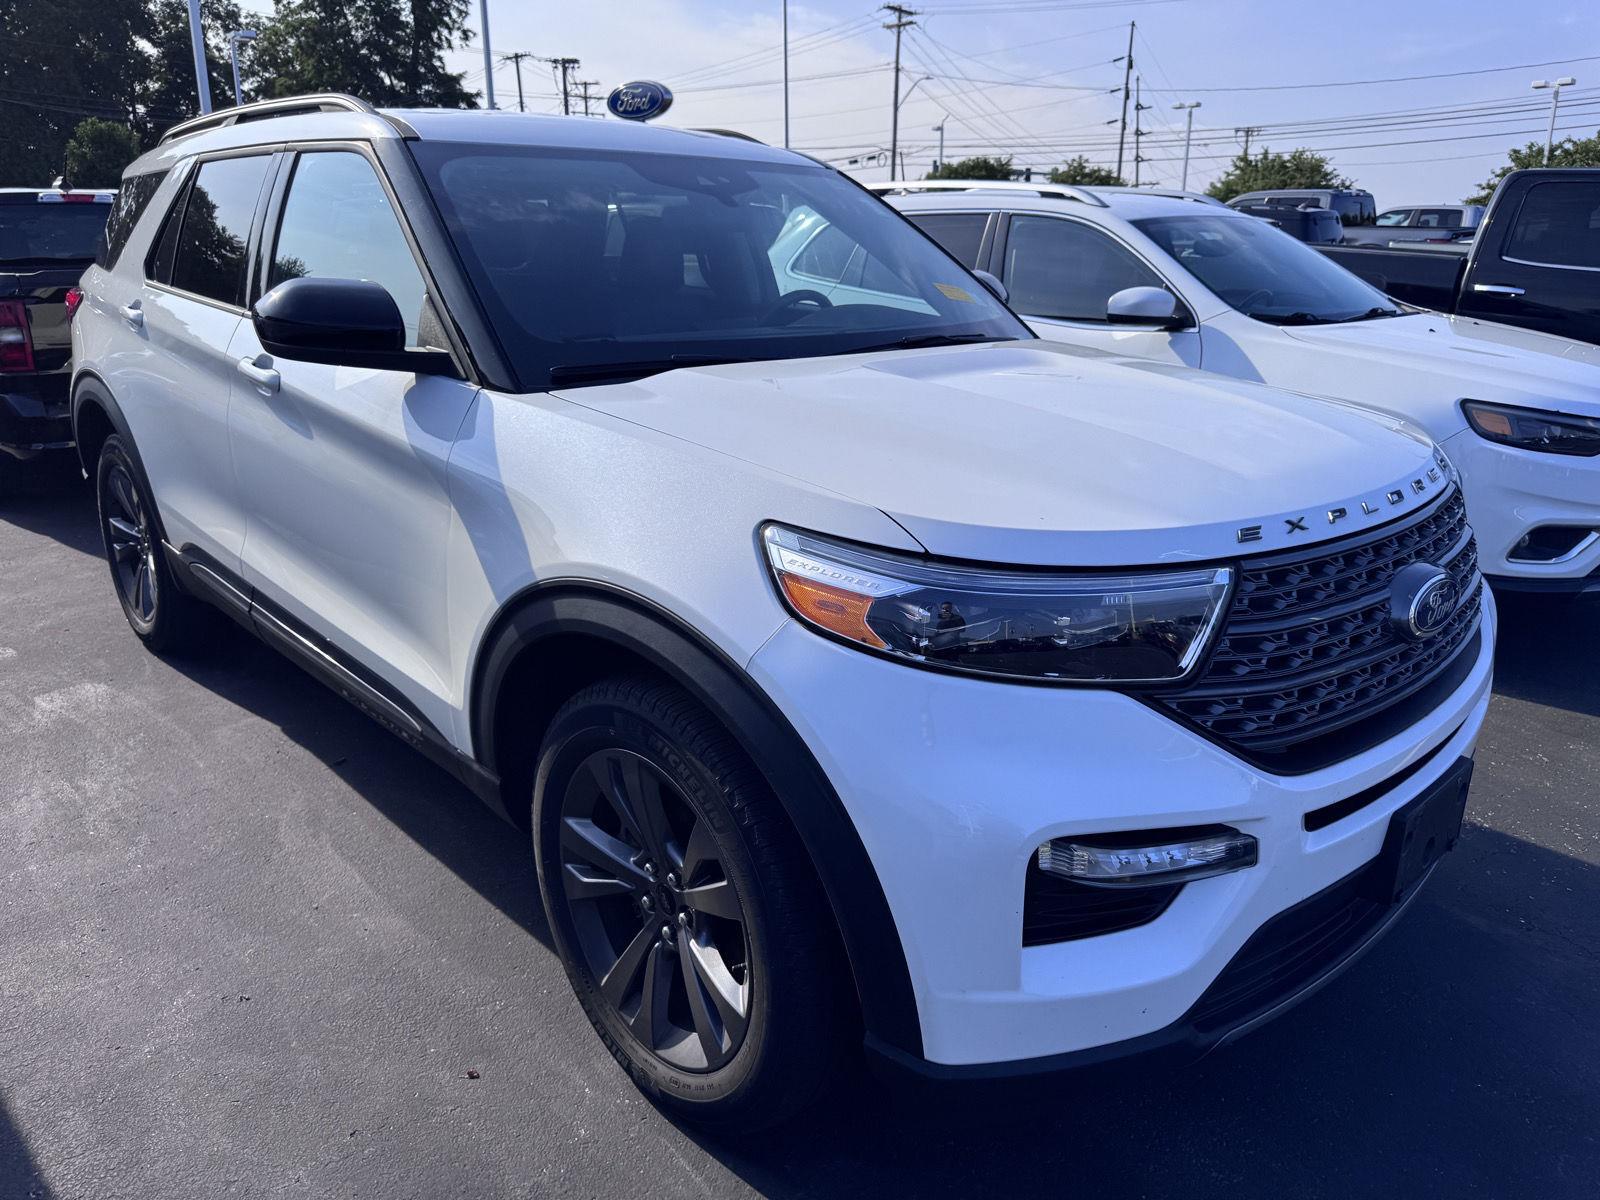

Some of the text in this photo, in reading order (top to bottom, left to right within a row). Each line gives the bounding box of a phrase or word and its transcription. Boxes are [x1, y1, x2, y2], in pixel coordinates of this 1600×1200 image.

[616, 88, 651, 112] Ford
[786, 557, 882, 591] EXPLORER
[1424, 586, 1456, 629] Ford
